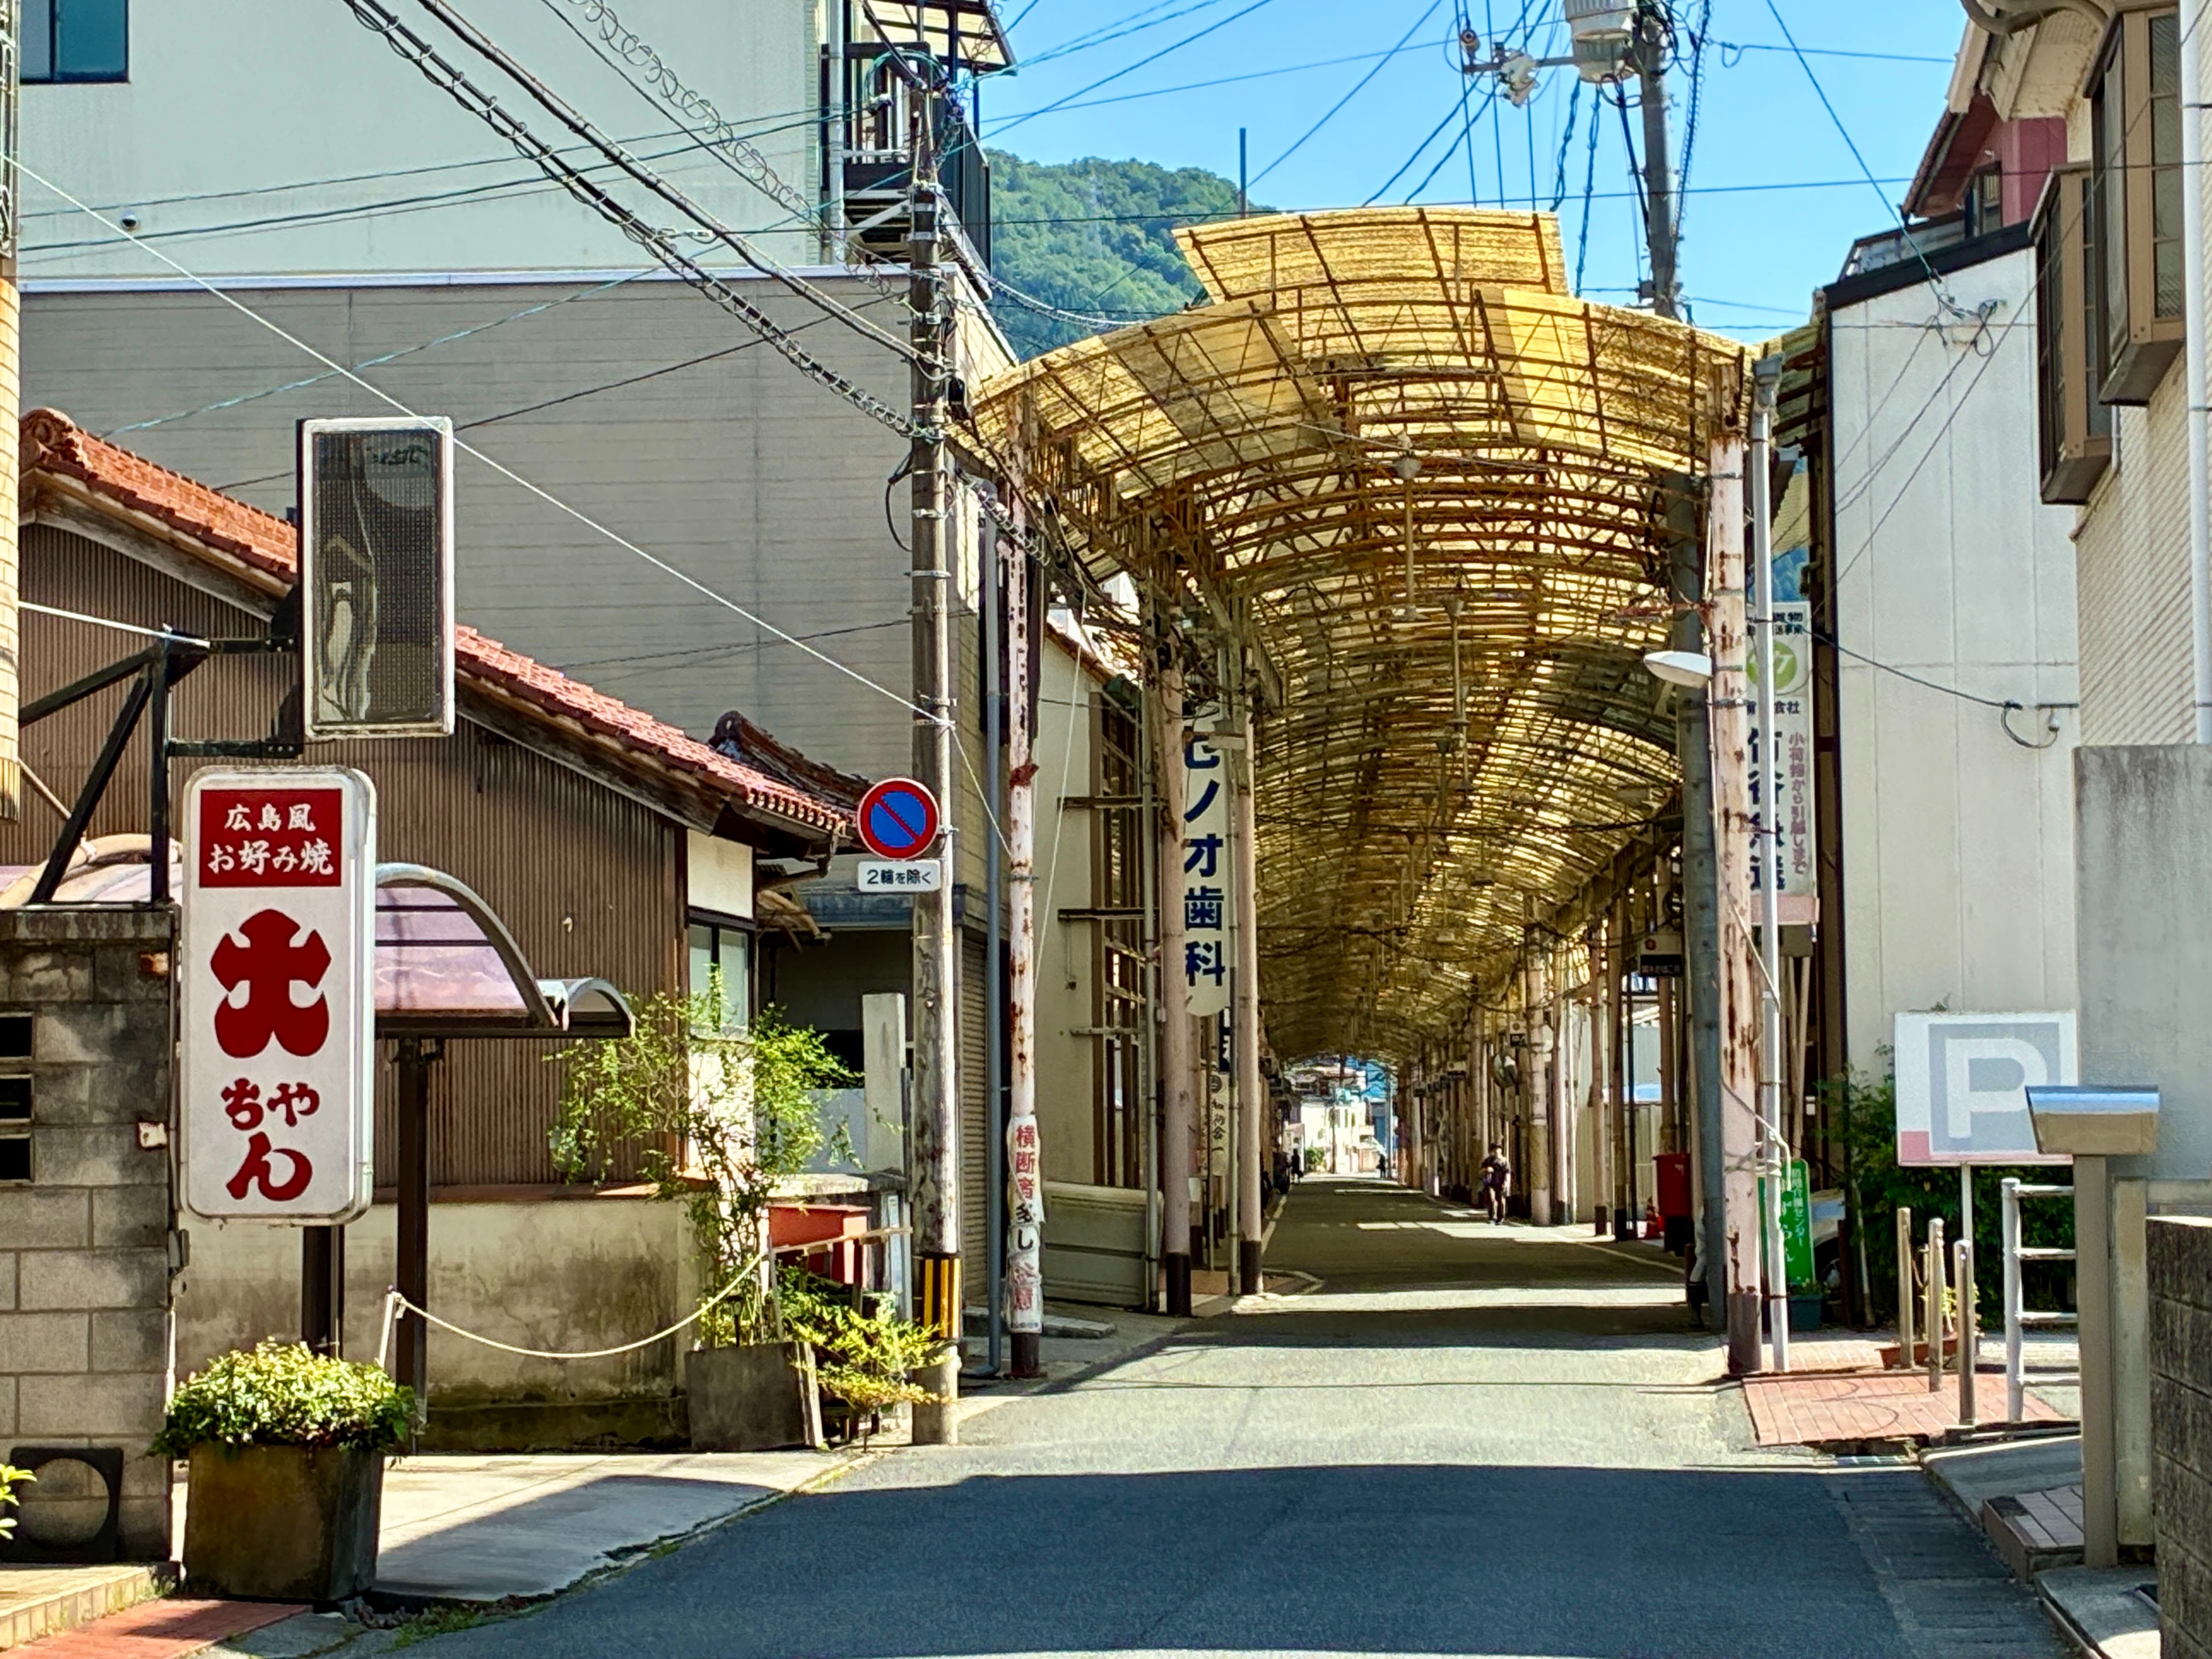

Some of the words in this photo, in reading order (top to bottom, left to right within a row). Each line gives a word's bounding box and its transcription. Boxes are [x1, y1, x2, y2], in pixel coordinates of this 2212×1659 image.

[1747, 700, 1801, 715] 有会社
[224, 802, 317, 833] 広島風
[207, 838, 334, 876] お好み焼
[866, 869, 932, 885] 2輪を除く
[1945, 1037, 2048, 1138] P
